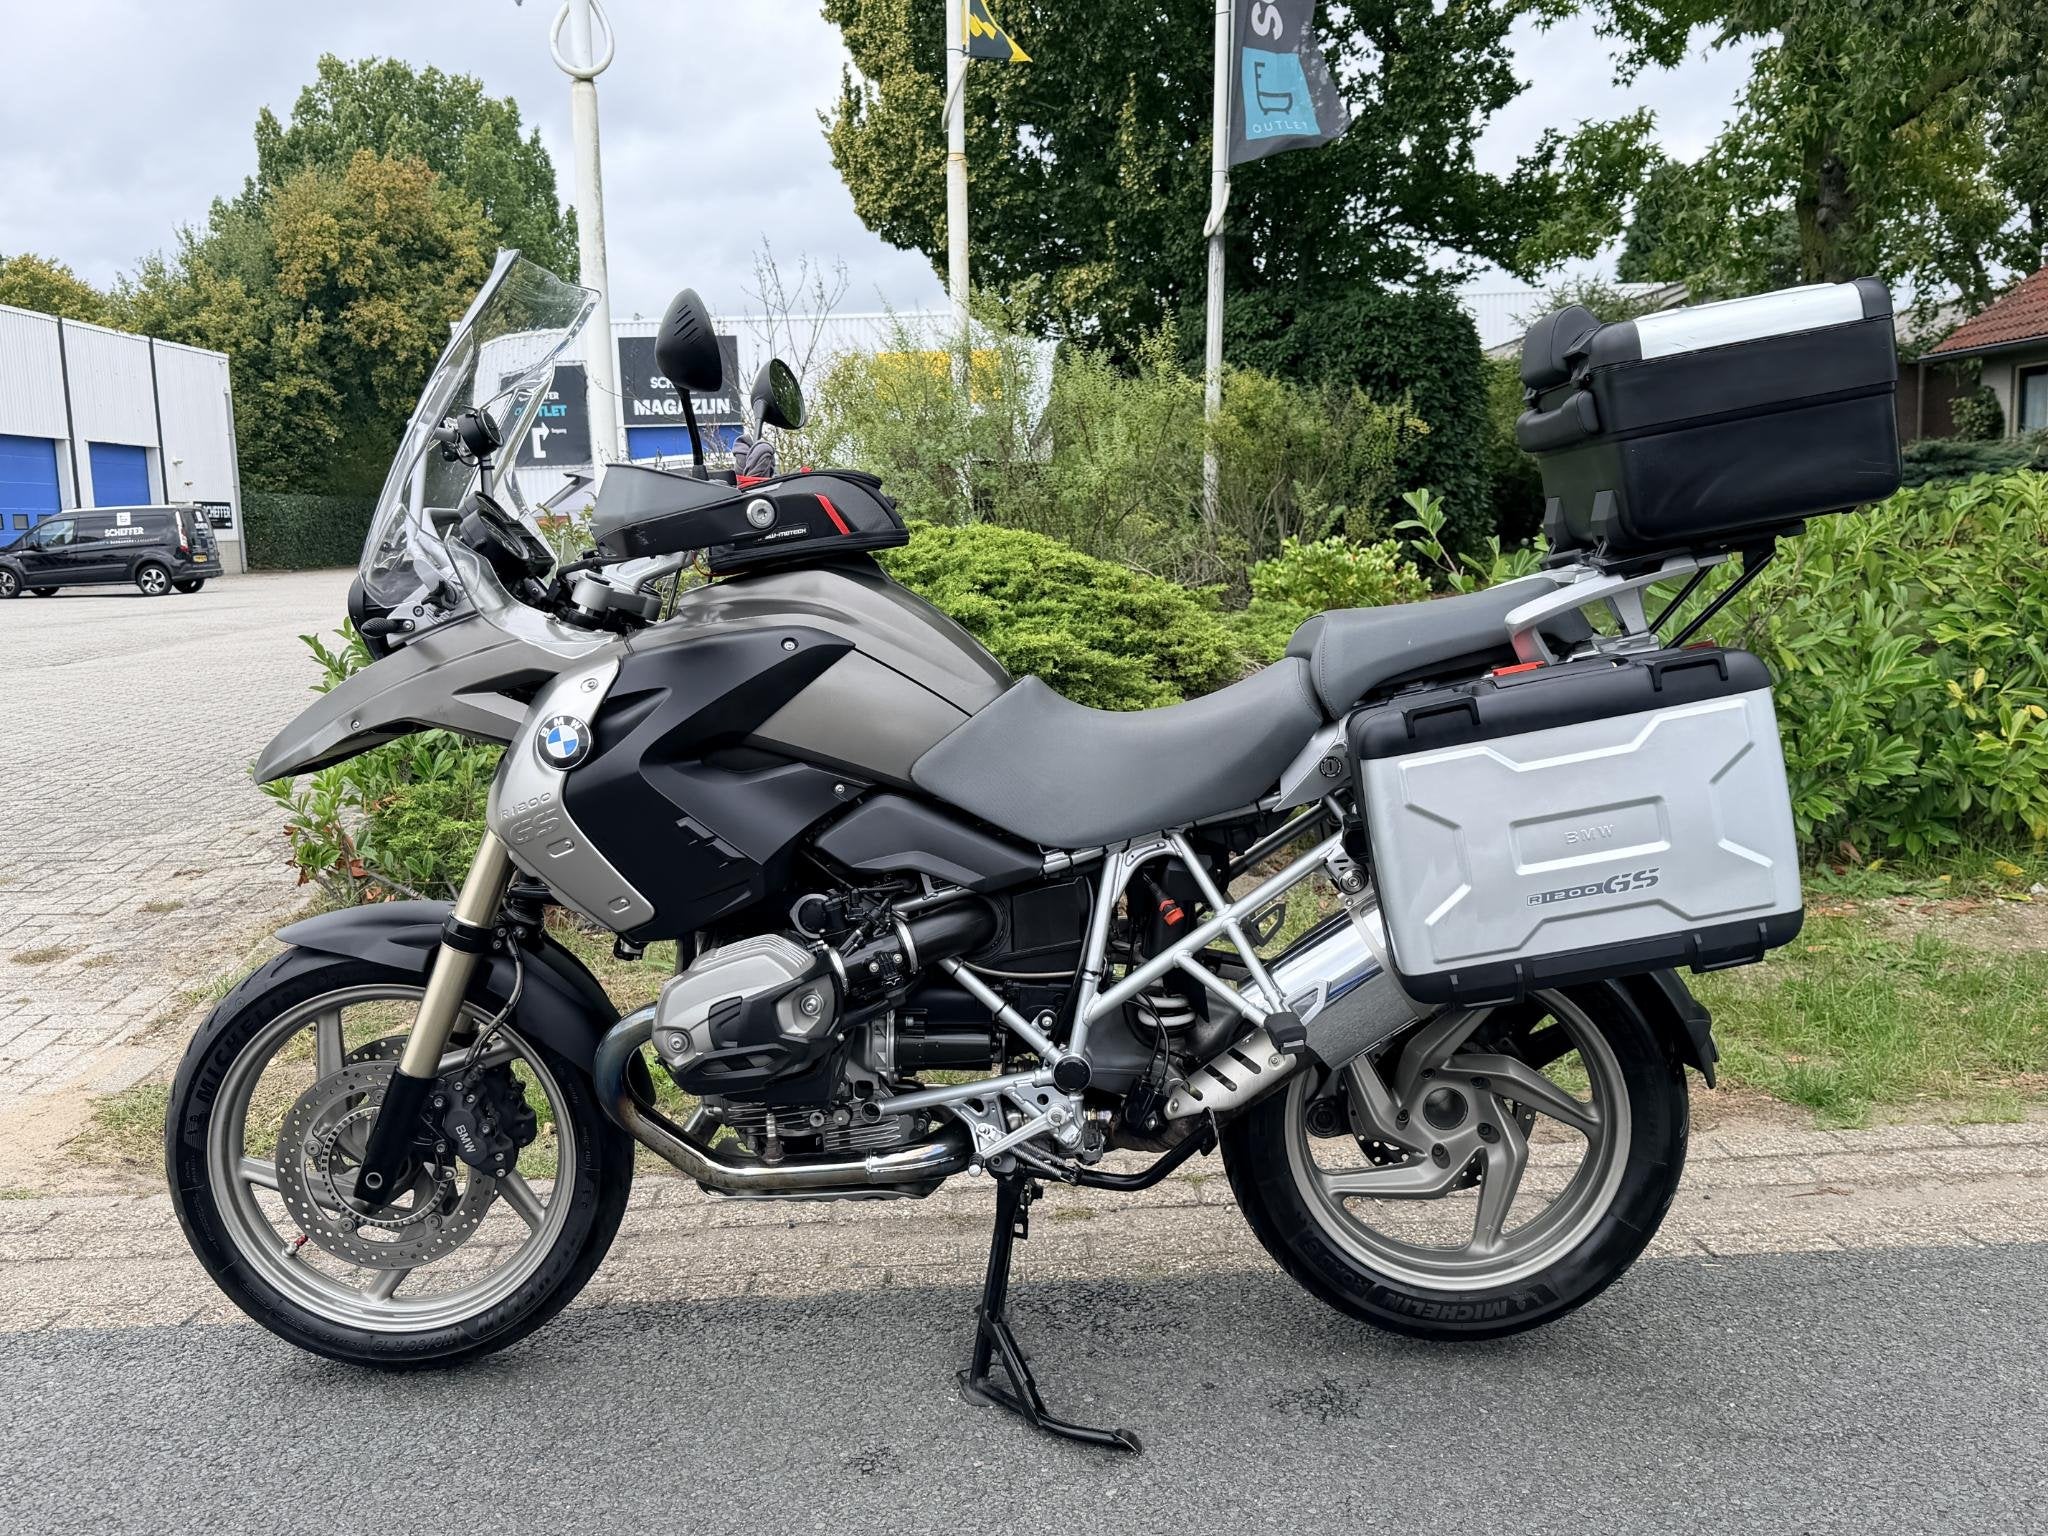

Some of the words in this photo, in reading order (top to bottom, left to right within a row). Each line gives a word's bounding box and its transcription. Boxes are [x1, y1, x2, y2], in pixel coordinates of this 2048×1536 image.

[1251, 0, 1284, 40] S
[1252, 120, 1308, 134] OUTLET
[514, 404, 568, 417] OTLET
[104, 527, 145, 537] SCHEFFER
[540, 717, 583, 738] BMW
[510, 807, 560, 845] GS
[1564, 824, 1616, 844] BMW
[455, 1124, 477, 1152] BMW
[1380, 1290, 1509, 1321] MICHELIN
